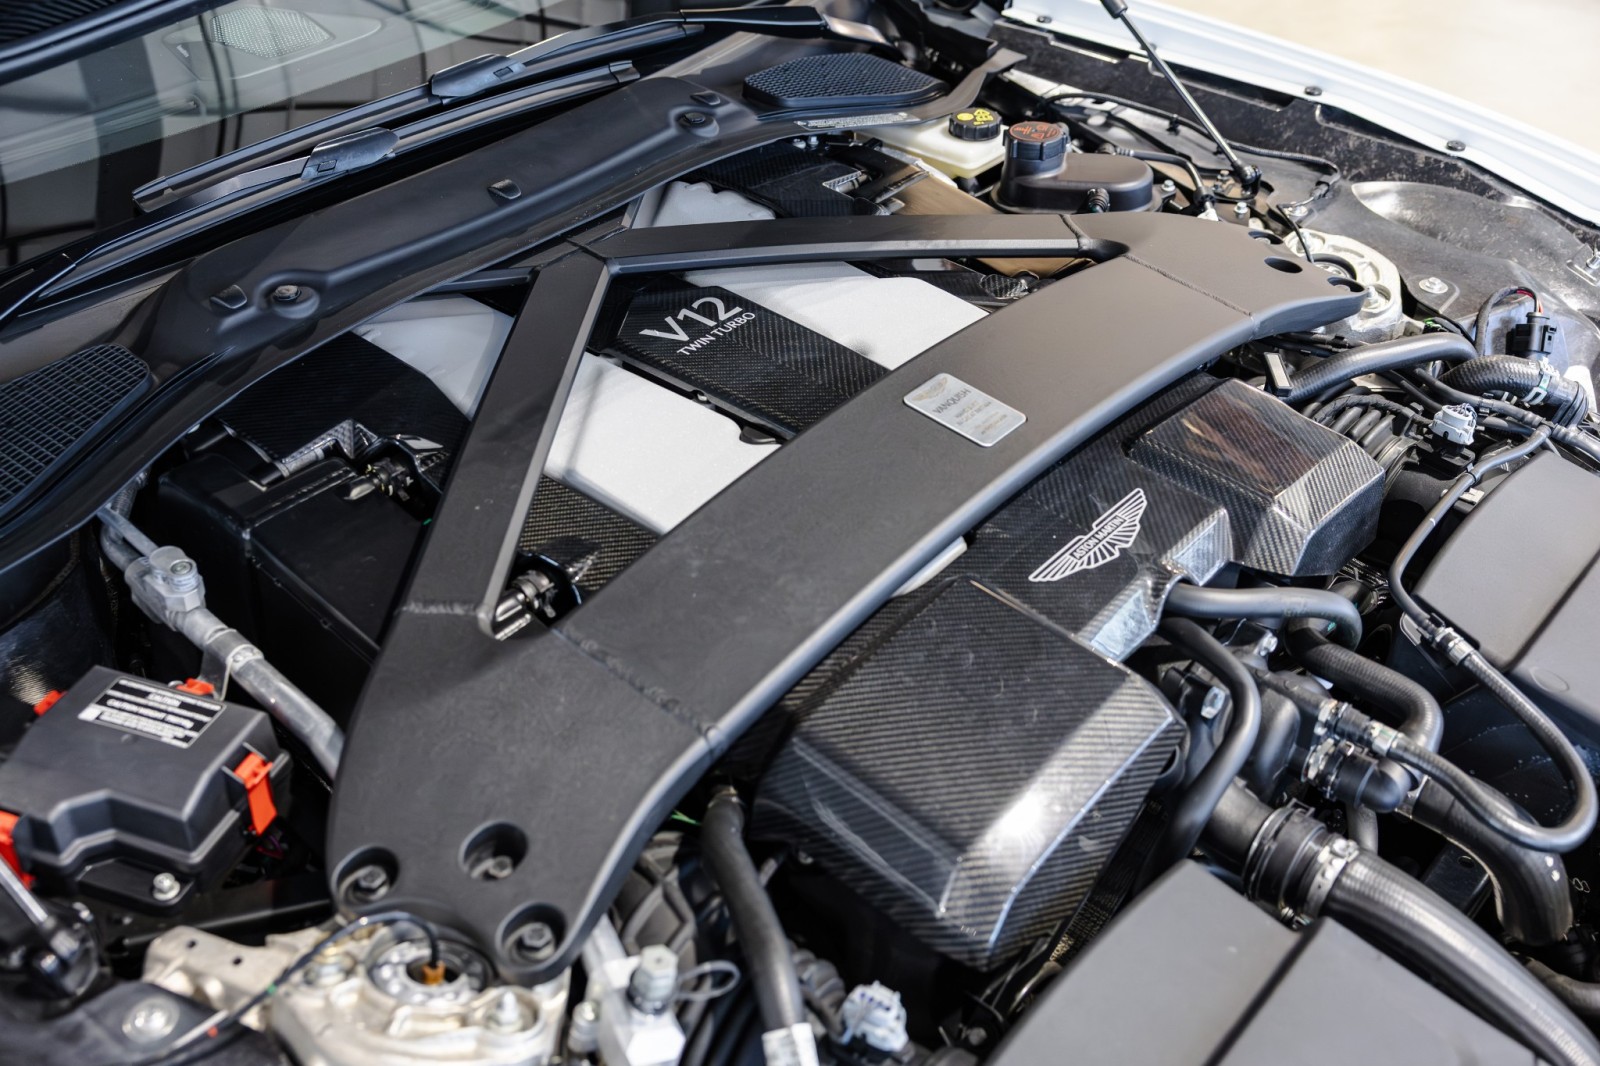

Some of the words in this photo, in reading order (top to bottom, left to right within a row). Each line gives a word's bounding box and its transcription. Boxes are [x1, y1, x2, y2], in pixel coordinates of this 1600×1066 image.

[638, 296, 743, 342] V12
[676, 334, 716, 356] TWIN
[710, 312, 756, 336] TURBO
[932, 388, 972, 414] VANQUISH
[1073, 536, 1100, 560] ASTON
[1094, 515, 1125, 543] MARTIN
